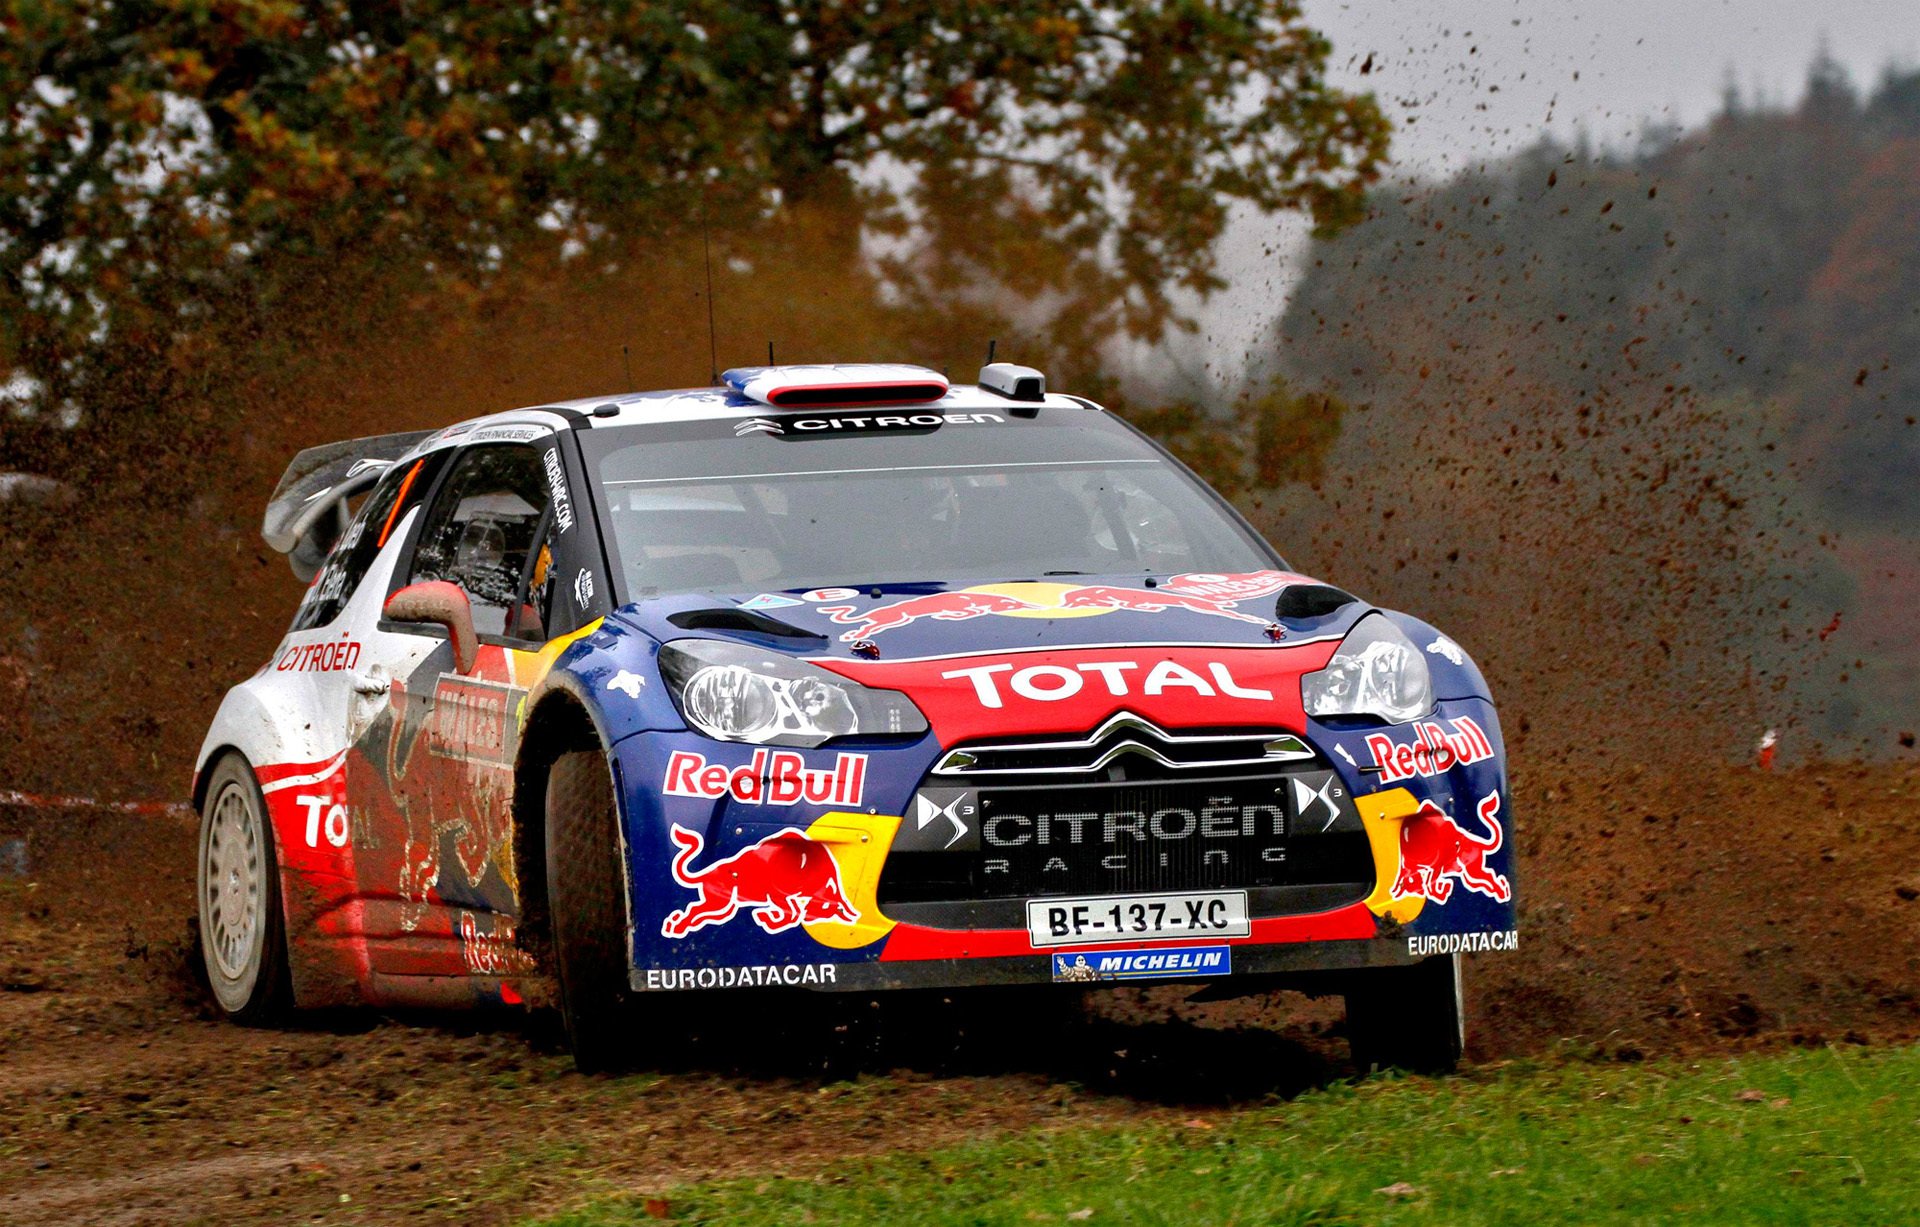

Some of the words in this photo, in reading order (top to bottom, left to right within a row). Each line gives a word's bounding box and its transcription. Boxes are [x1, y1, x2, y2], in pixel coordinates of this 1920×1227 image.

[942, 660, 1273, 708] TOTAL
[983, 796, 1285, 847] CITROËN
[984, 847, 1288, 875] RACING
[1048, 899, 1229, 938] BF-137-XC
[1407, 930, 1519, 956] EURODATACAR
[646, 963, 837, 989] EURODATACAR
[1100, 952, 1222, 972] MICHELIN
